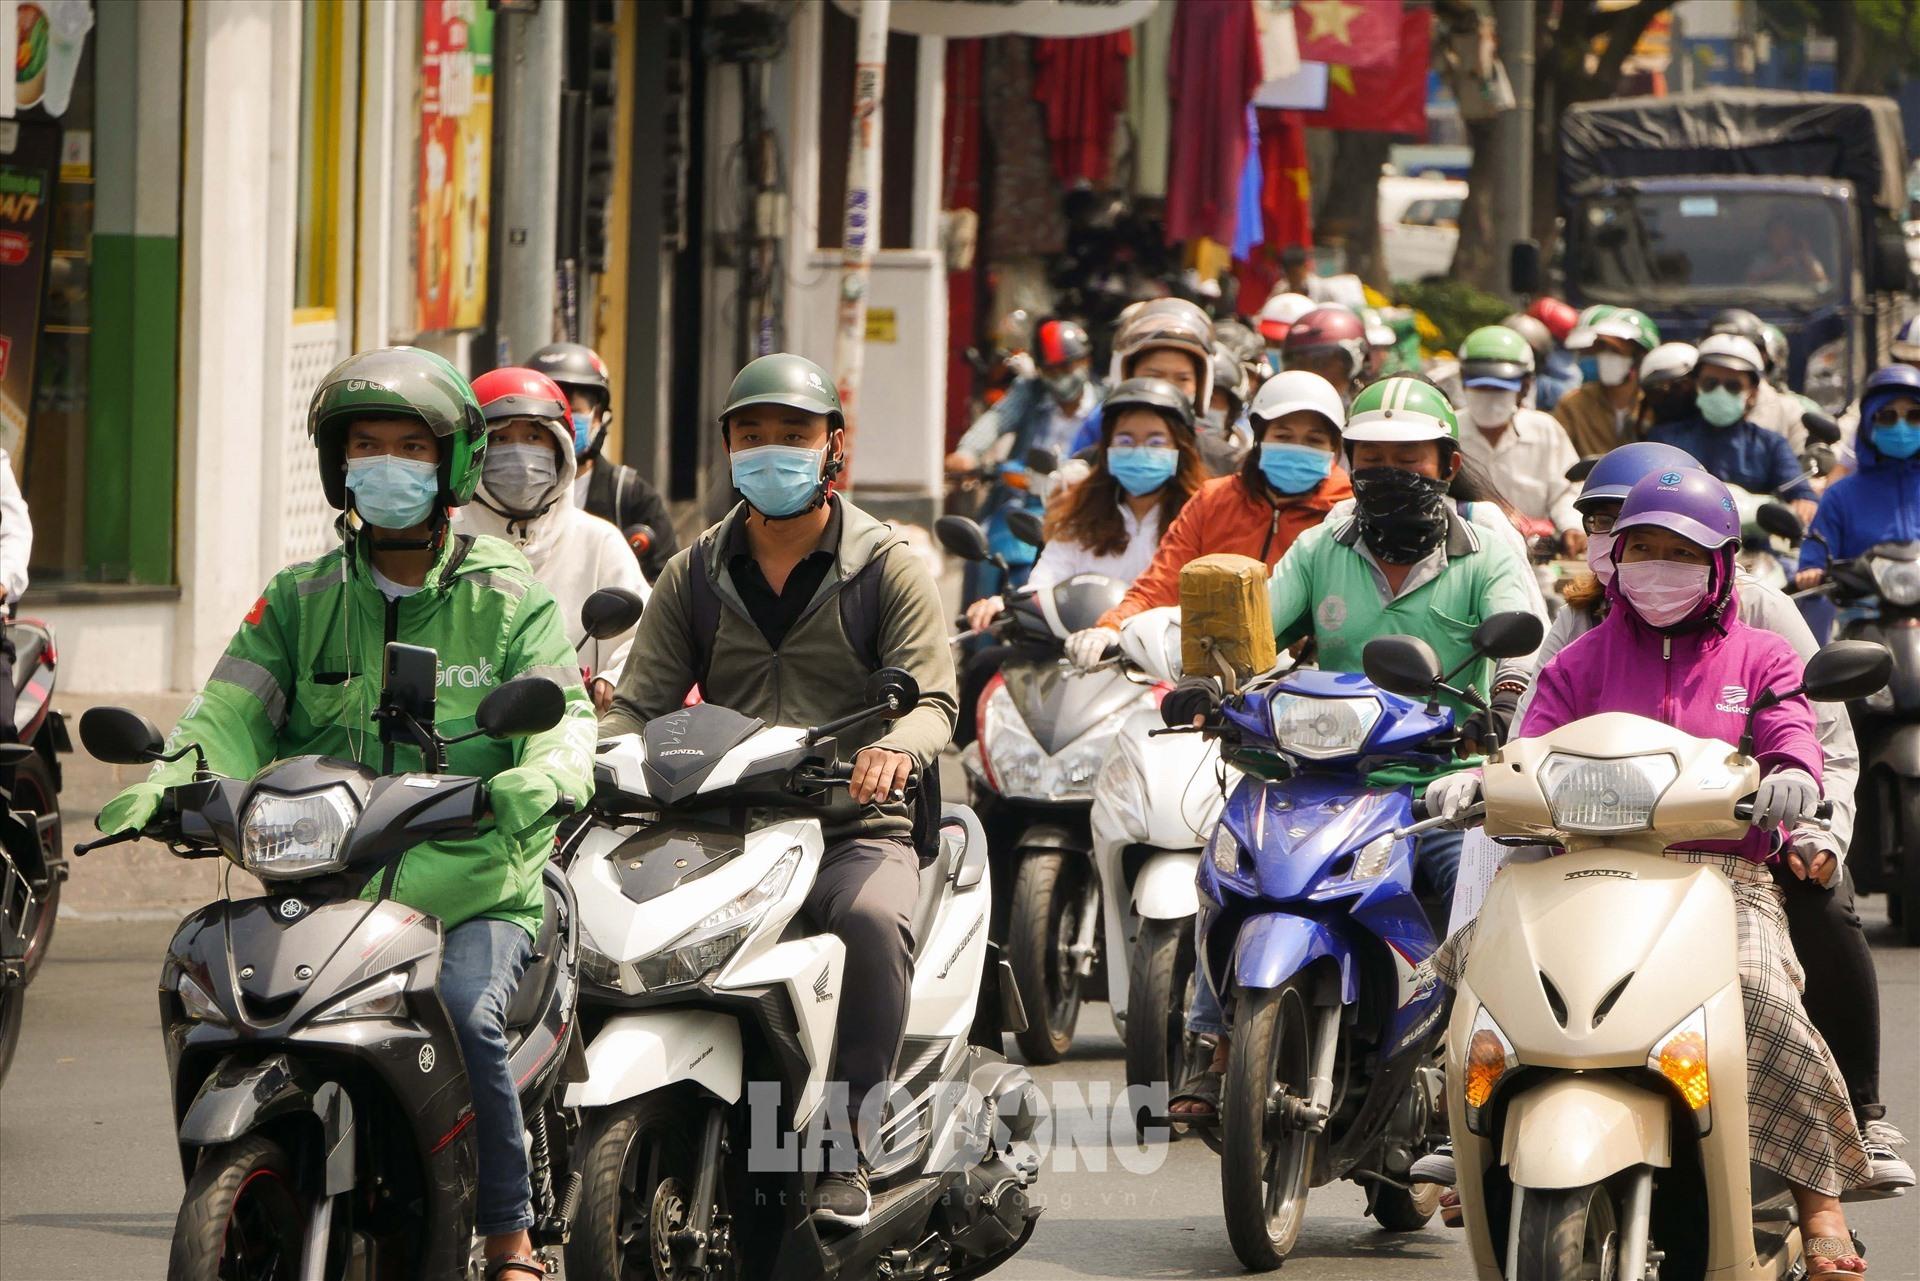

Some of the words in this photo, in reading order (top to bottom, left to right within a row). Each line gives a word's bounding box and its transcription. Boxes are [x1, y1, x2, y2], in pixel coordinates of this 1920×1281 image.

[1715, 703, 1751, 715] adidas
[660, 748, 705, 757] HONDA
[1401, 1003, 1442, 1047] SUZUKI
